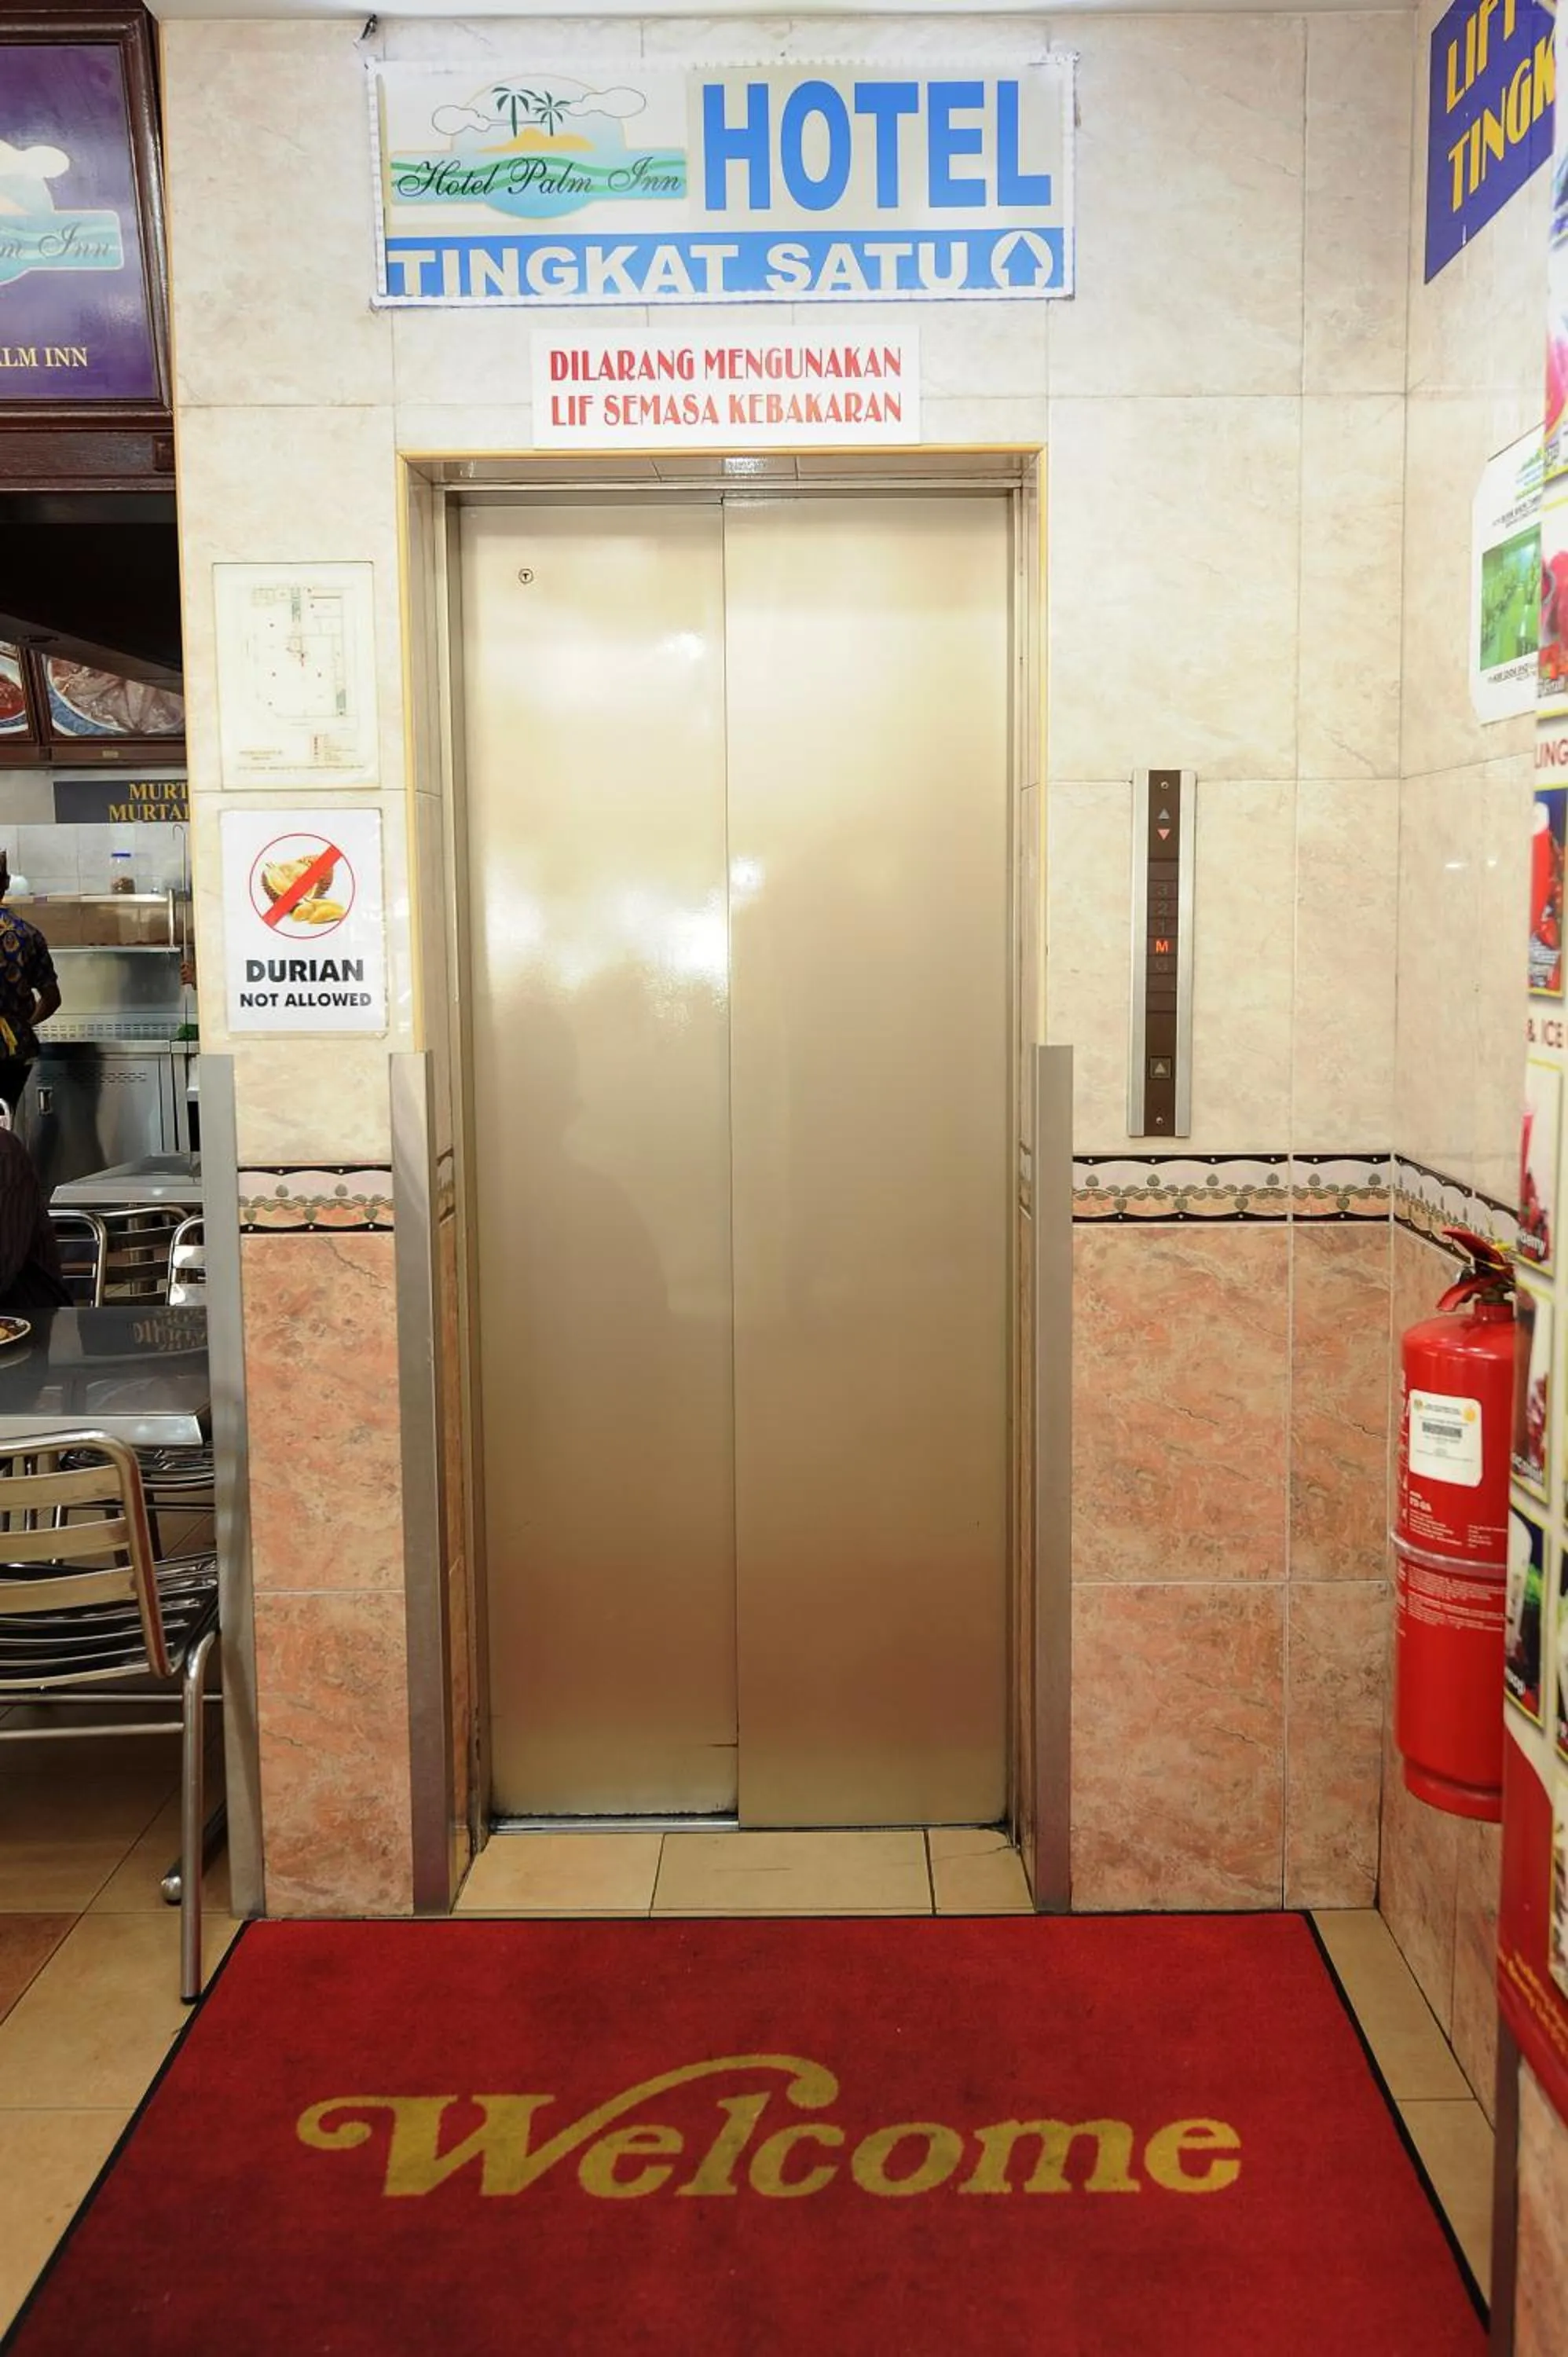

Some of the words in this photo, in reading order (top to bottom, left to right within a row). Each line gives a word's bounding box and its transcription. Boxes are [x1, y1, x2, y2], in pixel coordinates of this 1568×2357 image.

[702, 79, 1052, 211] HOTEL
[397, 159, 500, 196] Hotel
[507, 157, 593, 195] Palm
[607, 156, 680, 193] Inn
[38, 222, 108, 258] Inn
[388, 244, 741, 295] TINGKAT
[765, 242, 969, 291] SATU
[44, 346, 88, 367] INN
[549, 348, 694, 381] DILARANG
[705, 347, 901, 379] MENGUNAKAN
[551, 394, 594, 426] LIF
[604, 394, 719, 426] SEMASA
[729, 392, 901, 425] KEBAKARAN
[1156, 940, 1169, 953] M
[246, 959, 364, 983] DURIAN
[240, 992, 279, 1007] NOT
[284, 992, 372, 1007] ALLOWED
[296, 2055, 1241, 2198] Welcome
